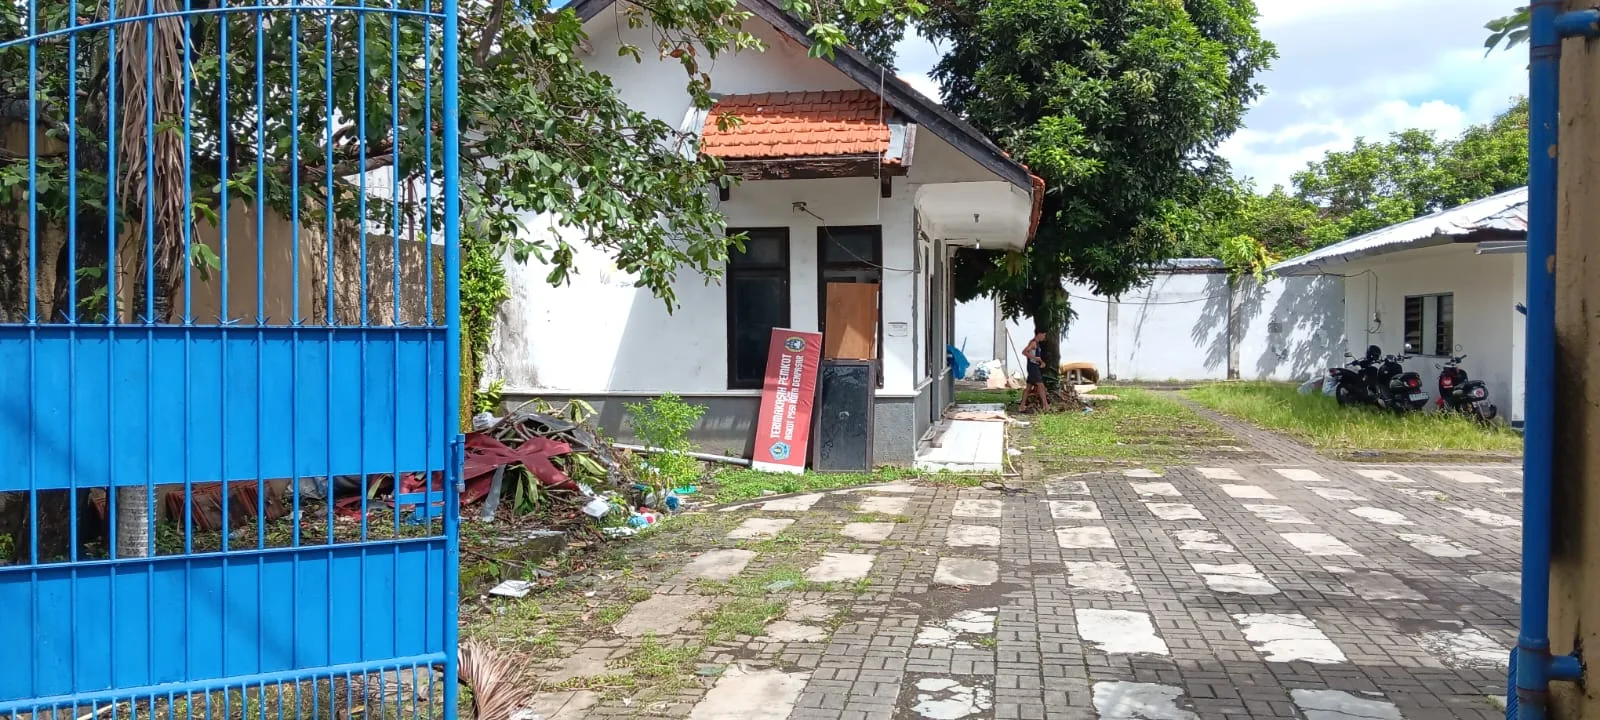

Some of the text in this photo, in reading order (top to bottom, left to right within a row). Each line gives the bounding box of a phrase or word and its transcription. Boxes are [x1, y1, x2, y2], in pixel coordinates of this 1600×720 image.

[778, 354, 792, 385] PEMKOT
[792, 355, 804, 387] DENPASAR
[770, 387, 787, 438] TERIMAKASIH
[788, 404, 797, 419] PSSI
